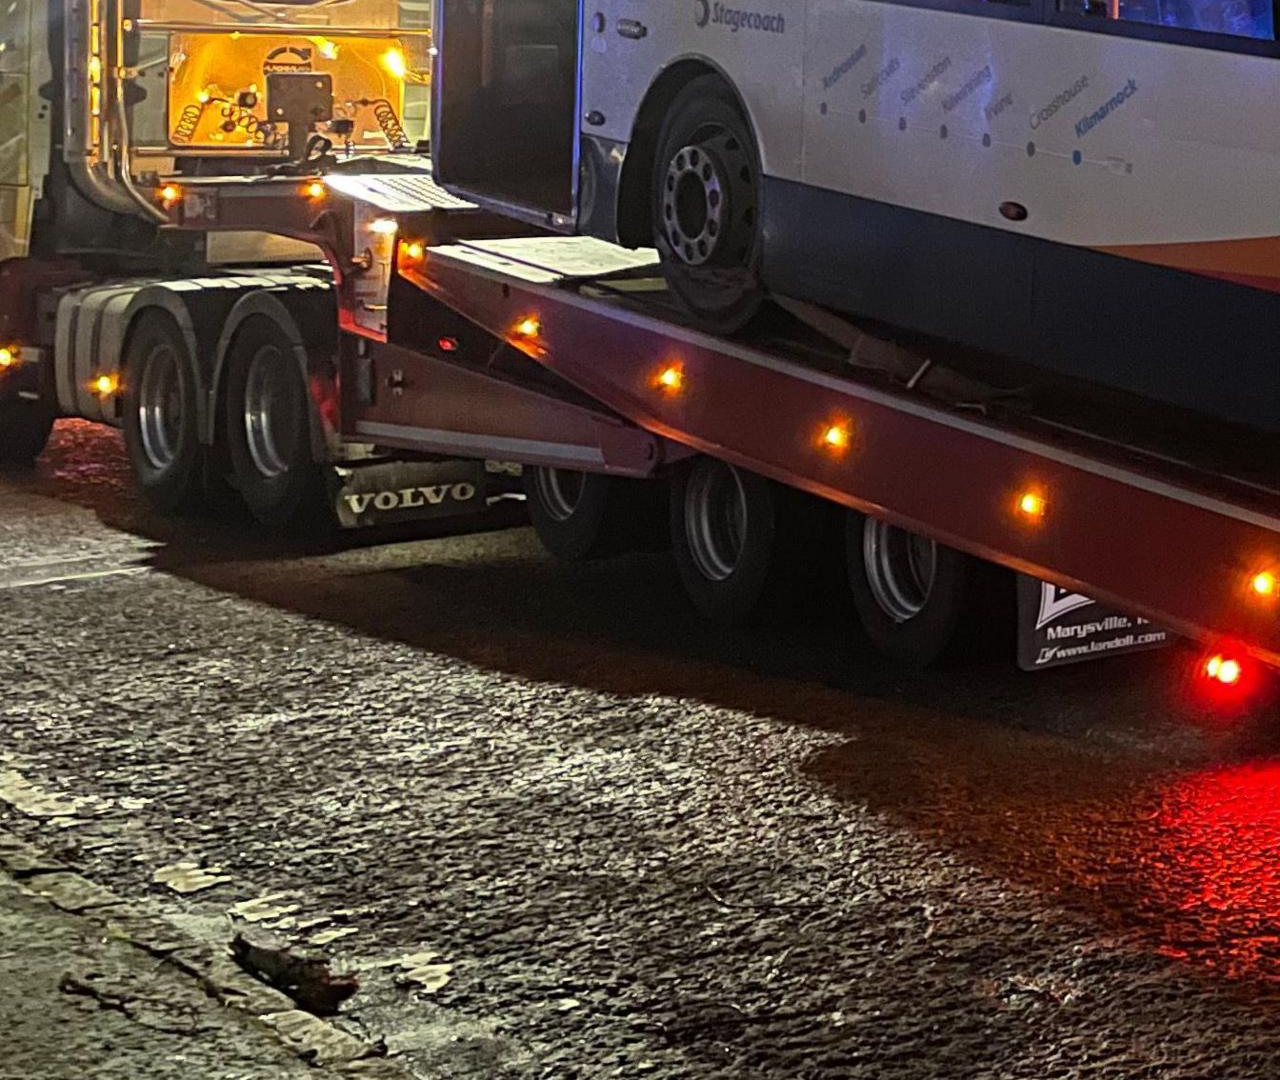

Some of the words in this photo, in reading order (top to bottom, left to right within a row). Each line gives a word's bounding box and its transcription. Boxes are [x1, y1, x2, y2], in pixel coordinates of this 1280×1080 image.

[712, 1, 785, 34] Stagecoach
[344, 482, 476, 514] VOLVO
[1056, 631, 1166, 659] www.landoll.com
